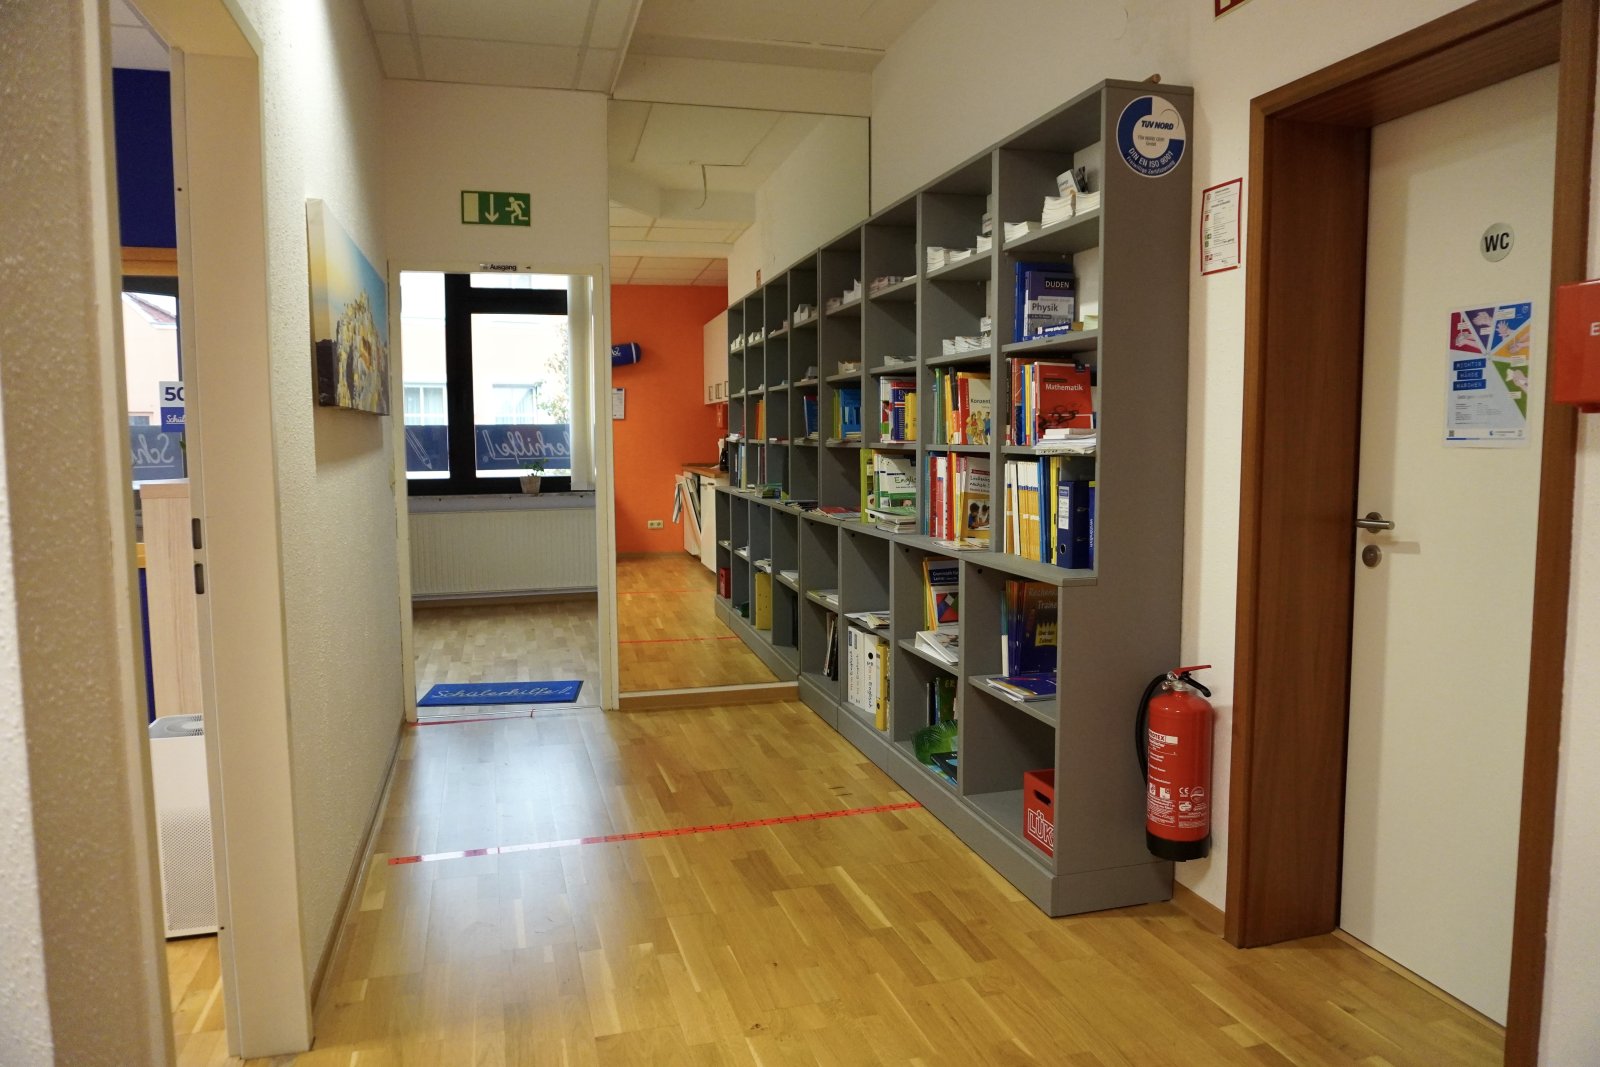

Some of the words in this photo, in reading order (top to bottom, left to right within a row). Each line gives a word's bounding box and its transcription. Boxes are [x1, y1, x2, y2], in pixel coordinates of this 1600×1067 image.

[1154, 121, 1174, 131] NORD
[1138, 157, 1148, 167] EN
[1149, 160, 1160, 168] ISO
[1484, 232, 1510, 252] WC
[1032, 303, 1058, 312] Physik
